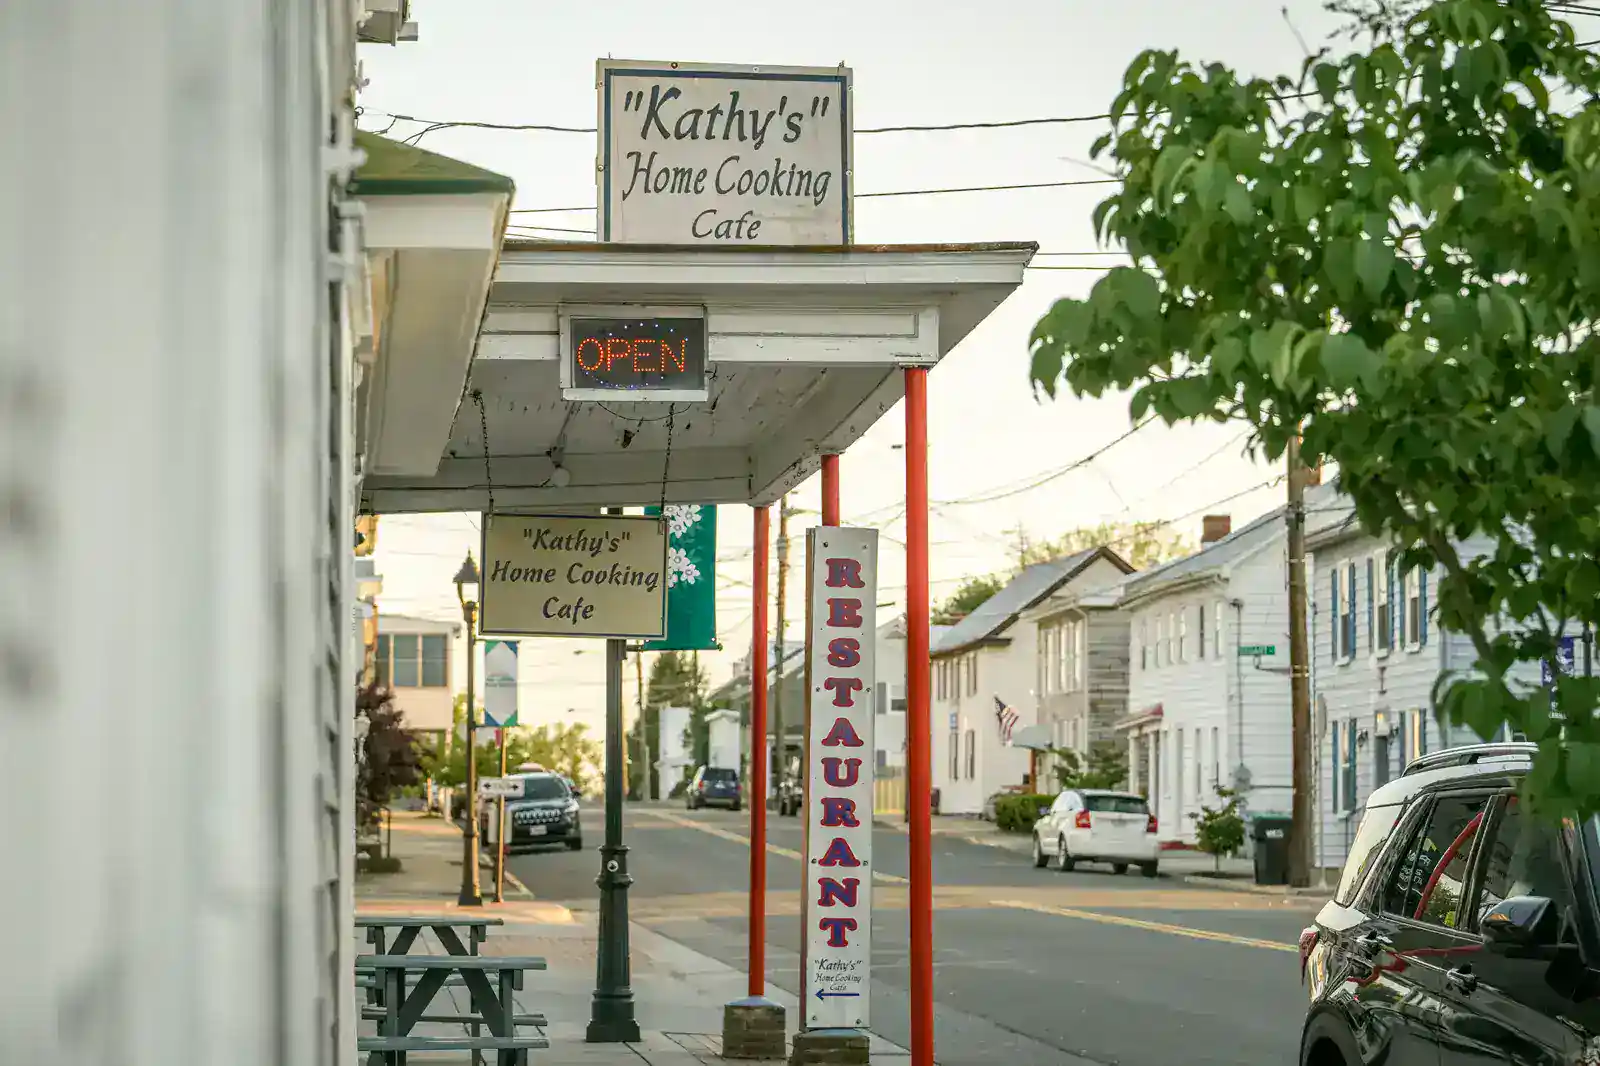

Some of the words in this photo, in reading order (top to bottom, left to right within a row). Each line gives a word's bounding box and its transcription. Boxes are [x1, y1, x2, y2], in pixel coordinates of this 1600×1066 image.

[623, 84, 830, 151] "Kathy's"
[621, 150, 708, 202] Home
[714, 155, 832, 207] Cooking
[691, 208, 762, 240] Cafe
[577, 337, 687, 372] OPEN
[523, 528, 631, 558] "Kathy's"
[490, 560, 557, 583] Home
[566, 562, 660, 593] Cooking
[542, 596, 595, 625] Cafe
[817, 557, 866, 948] RESTAURANT
[814, 958, 863, 972] "Kathy's"
[814, 972, 834, 983] Home
[835, 973, 862, 984] Cooking
